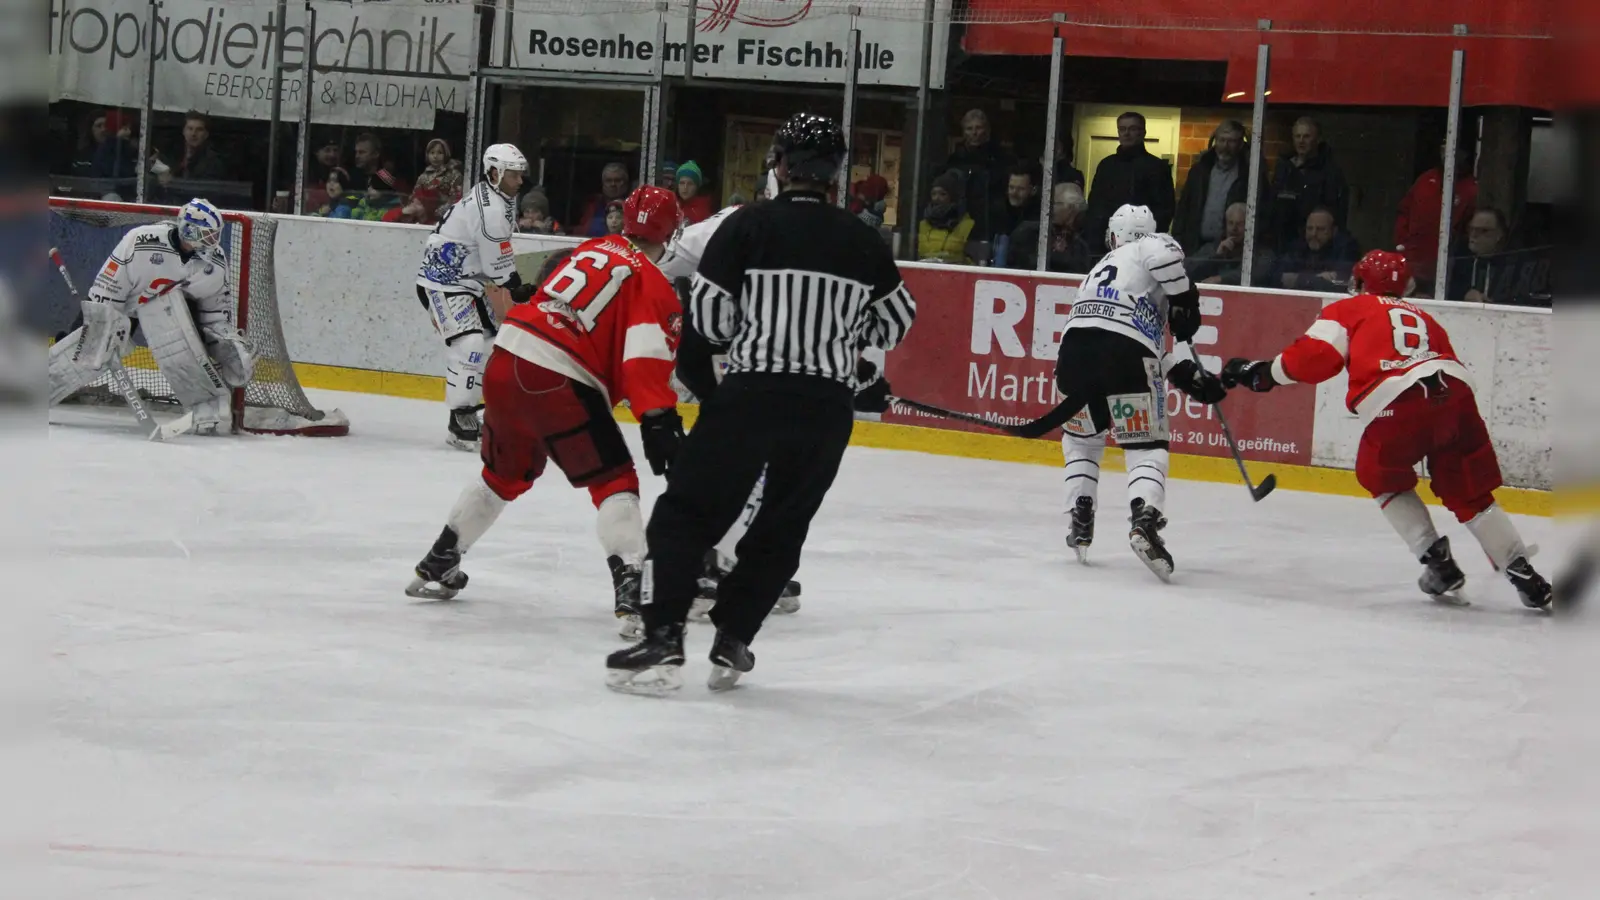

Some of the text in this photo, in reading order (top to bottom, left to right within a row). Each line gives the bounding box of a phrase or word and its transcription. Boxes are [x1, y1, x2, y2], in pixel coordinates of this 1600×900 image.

[529, 29, 895, 70] Rosenhemer Fischhalle
[320, 81, 336, 103] &
[344, 81, 456, 110] BALDHAM
[637, 210, 649, 225] 61
[543, 251, 632, 332] 61
[1096, 285, 1120, 300] EWL
[72, 324, 89, 362] VAUGHN
[970, 279, 1223, 375] REE
[1387, 307, 1430, 357] 8
[466, 375, 475, 390] 8
[967, 362, 1061, 405] Marti
[1112, 398, 1135, 419] do
[1187, 431, 1204, 445] 20
[1208, 433, 1231, 447] Uh
[1237, 438, 1299, 454] geöffnet.
